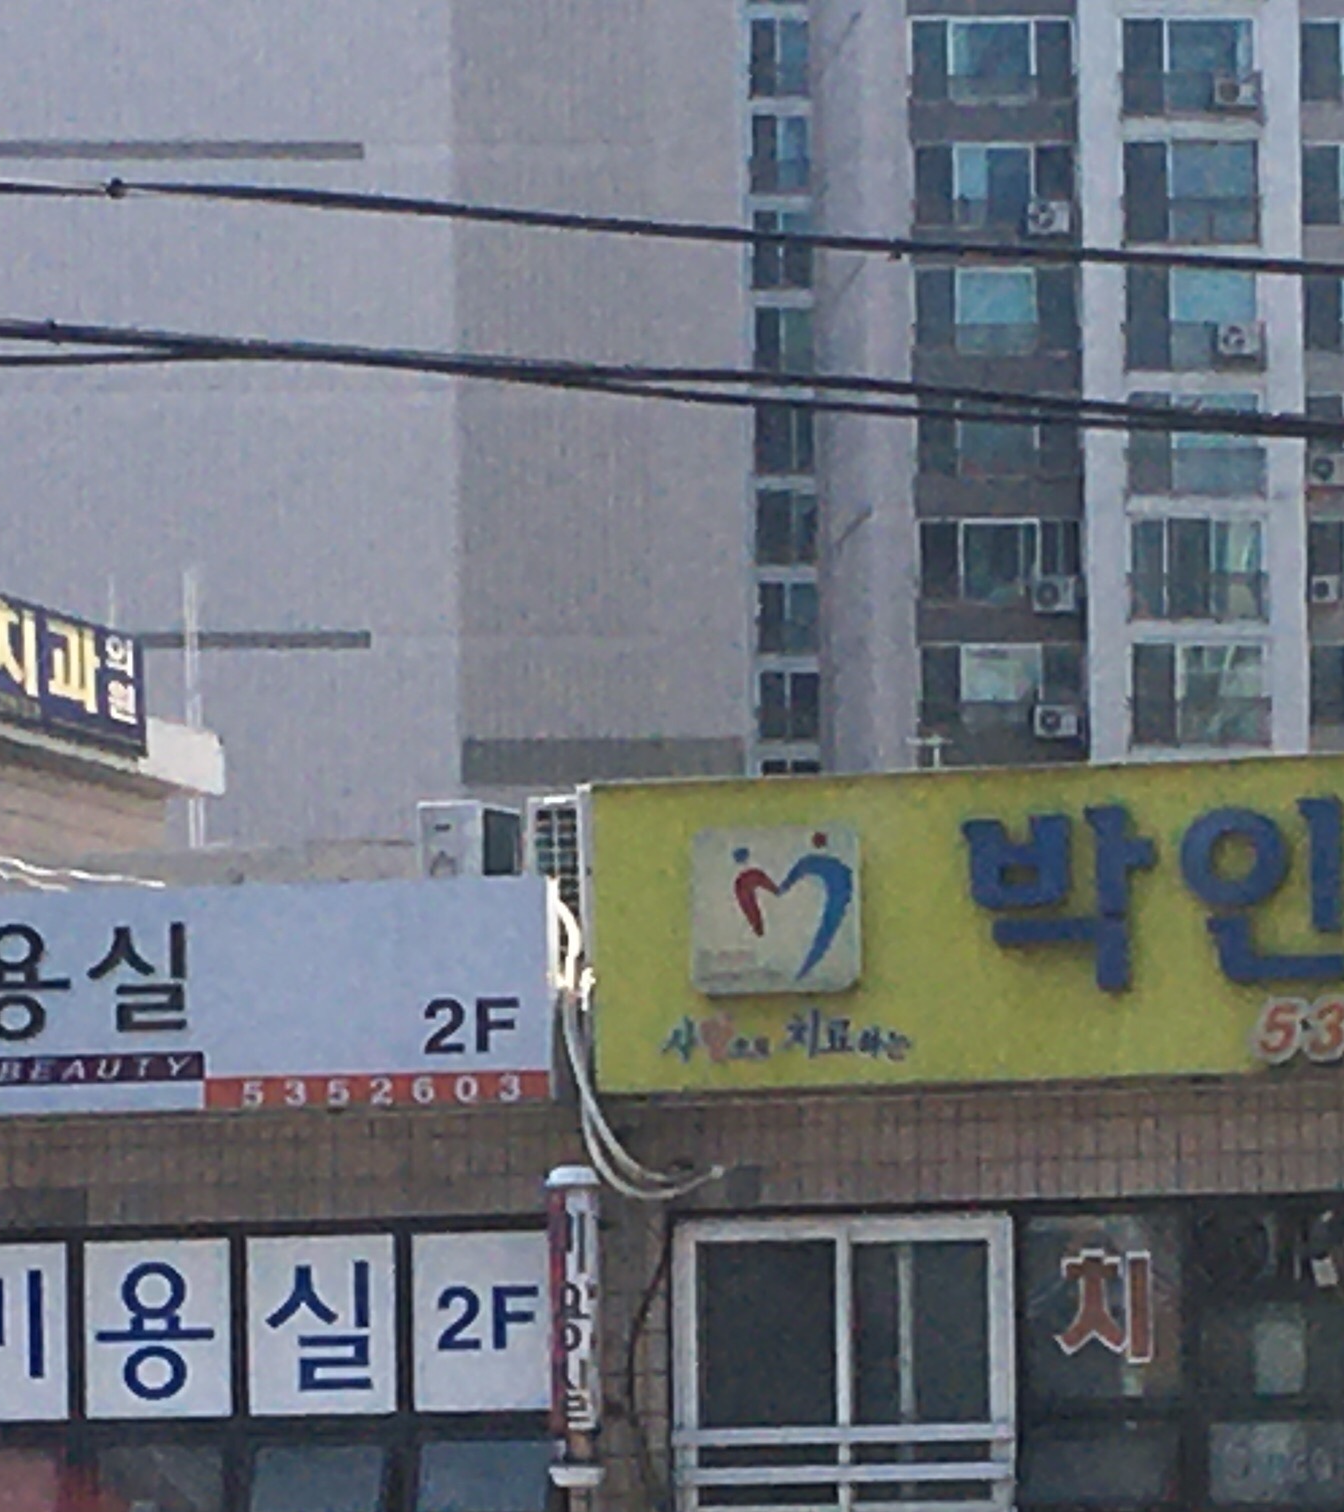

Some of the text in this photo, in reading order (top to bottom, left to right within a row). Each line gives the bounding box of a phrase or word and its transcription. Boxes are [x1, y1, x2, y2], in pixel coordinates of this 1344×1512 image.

[105, 635, 137, 725] 의원
[424, 998, 519, 1054] 2F
[242, 1074, 522, 1107] 5352603
[437, 1285, 538, 1350] 2F
[1054, 1248, 1151, 1363] 치
